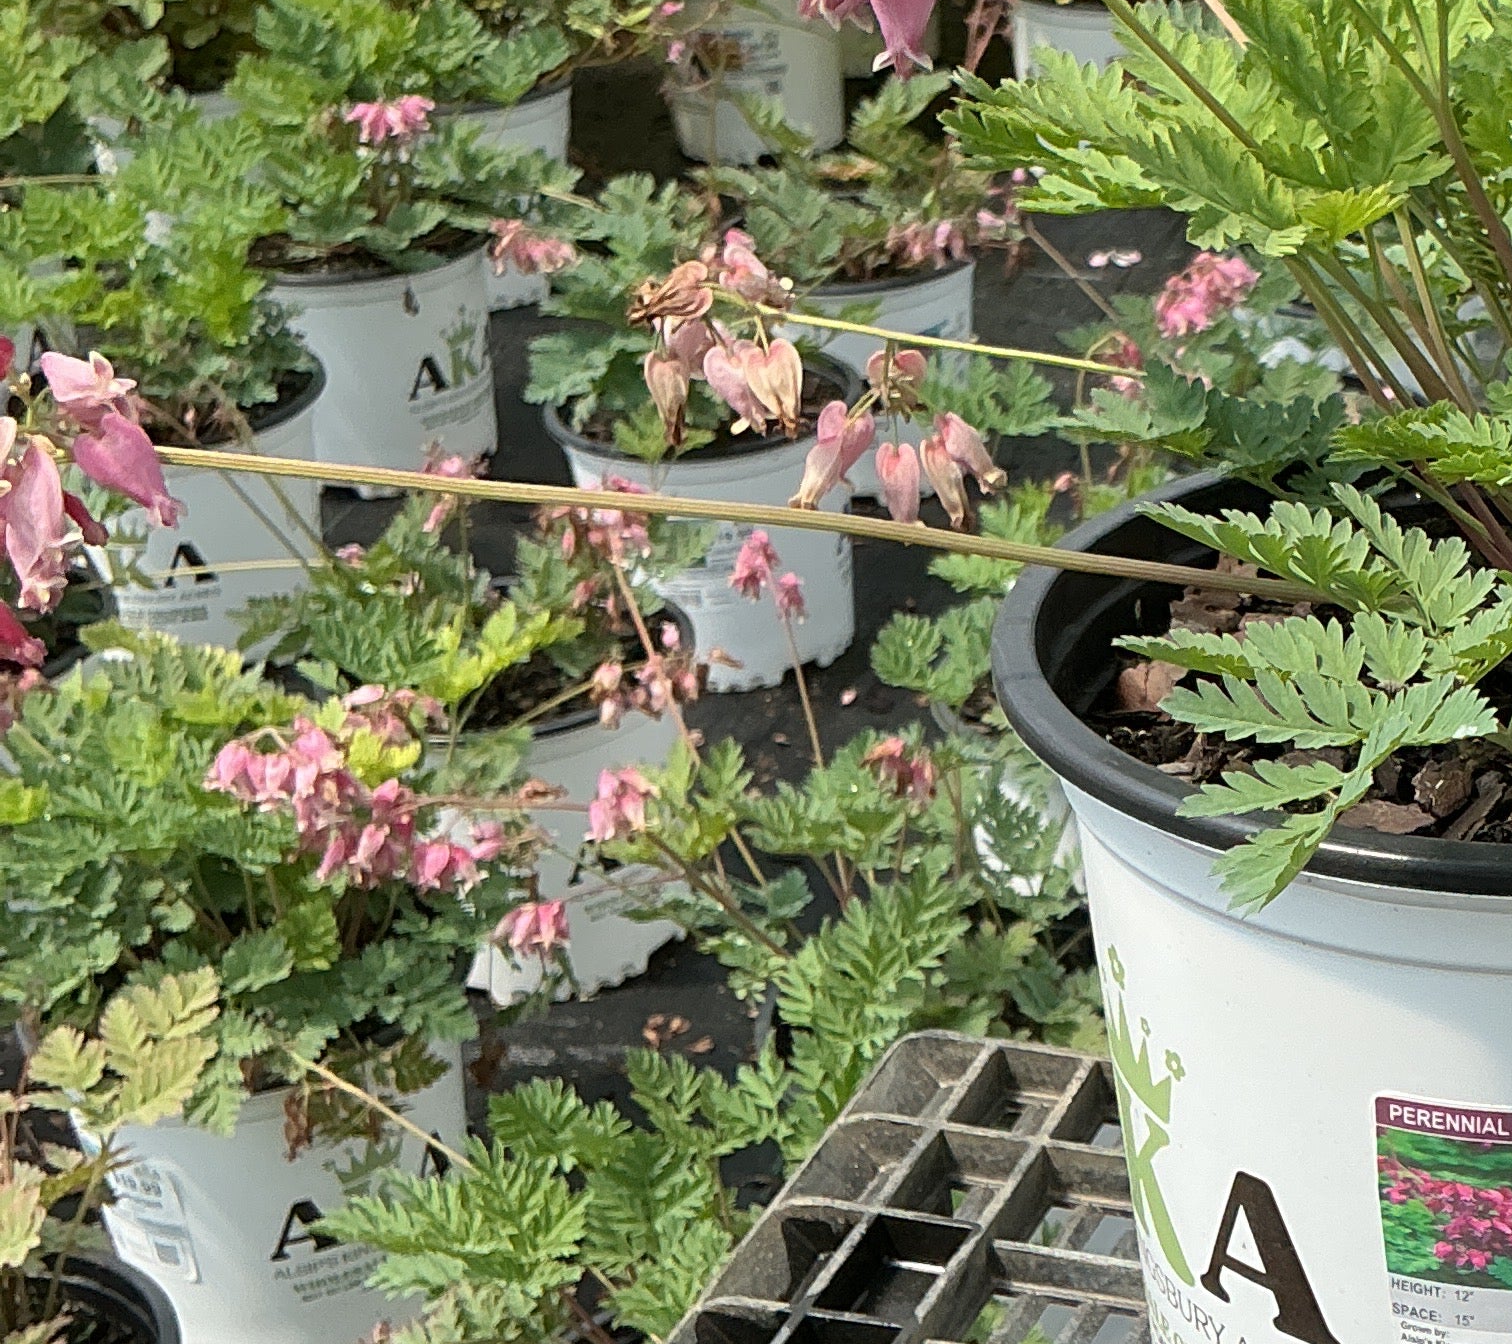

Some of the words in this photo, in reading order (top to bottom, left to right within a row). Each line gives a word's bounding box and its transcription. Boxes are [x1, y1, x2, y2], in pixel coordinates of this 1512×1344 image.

[1388, 1103, 1510, 1137] PERENNIAL
[1391, 1277, 1446, 1299] HEIGHT:
[1391, 1302, 1442, 1323] SPACE:
[1400, 1320, 1432, 1335] Grown
